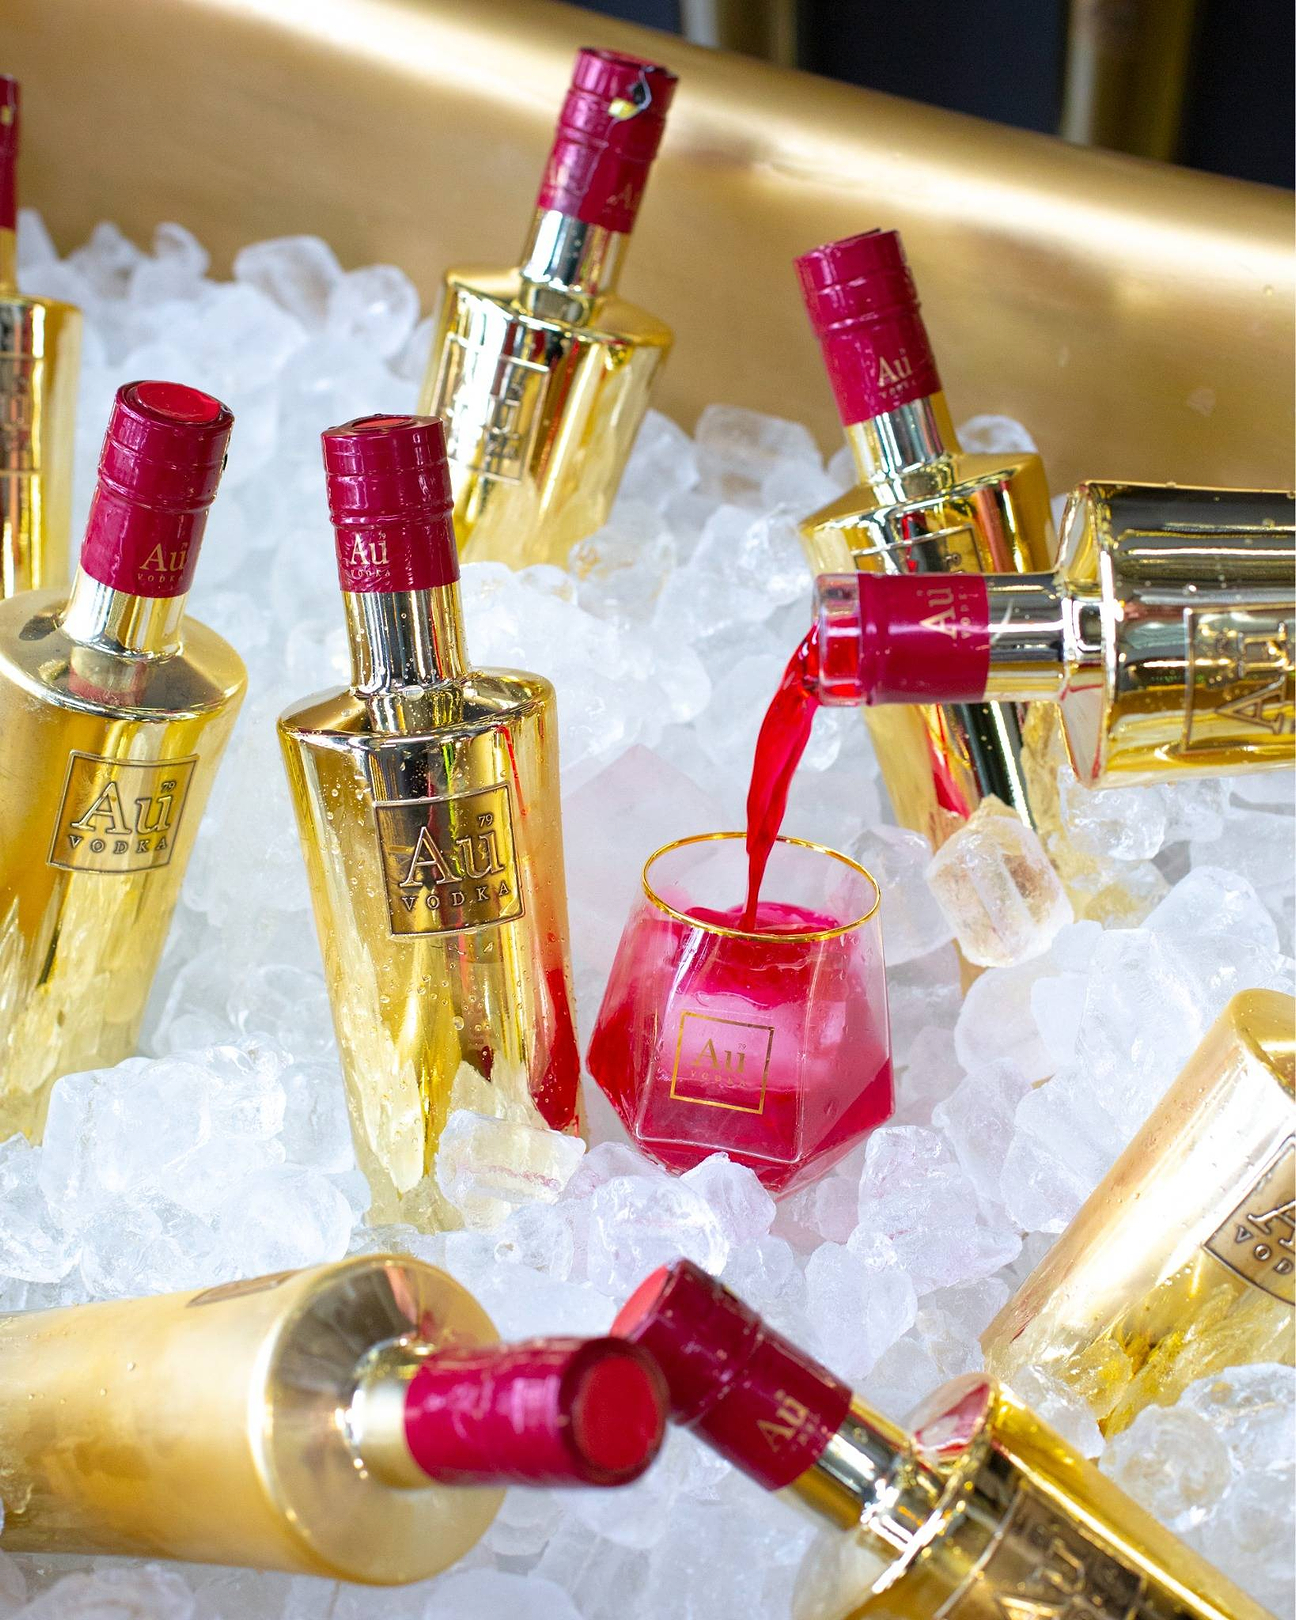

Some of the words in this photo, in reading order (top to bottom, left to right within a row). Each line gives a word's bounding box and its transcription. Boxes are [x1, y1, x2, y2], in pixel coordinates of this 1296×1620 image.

[877, 356, 912, 387] Au
[139, 542, 187, 571] Au
[350, 532, 390, 565] Au
[919, 587, 958, 640] Au
[1214, 622, 1293, 735] Au
[70, 781, 172, 835] Au
[161, 780, 177, 793] 79
[68, 834, 169, 855] VODKA
[400, 826, 506, 888] Au
[478, 813, 494, 828] 79
[401, 880, 510, 912] VODKA
[691, 1038, 746, 1074] Au
[756, 1394, 810, 1453] Au
